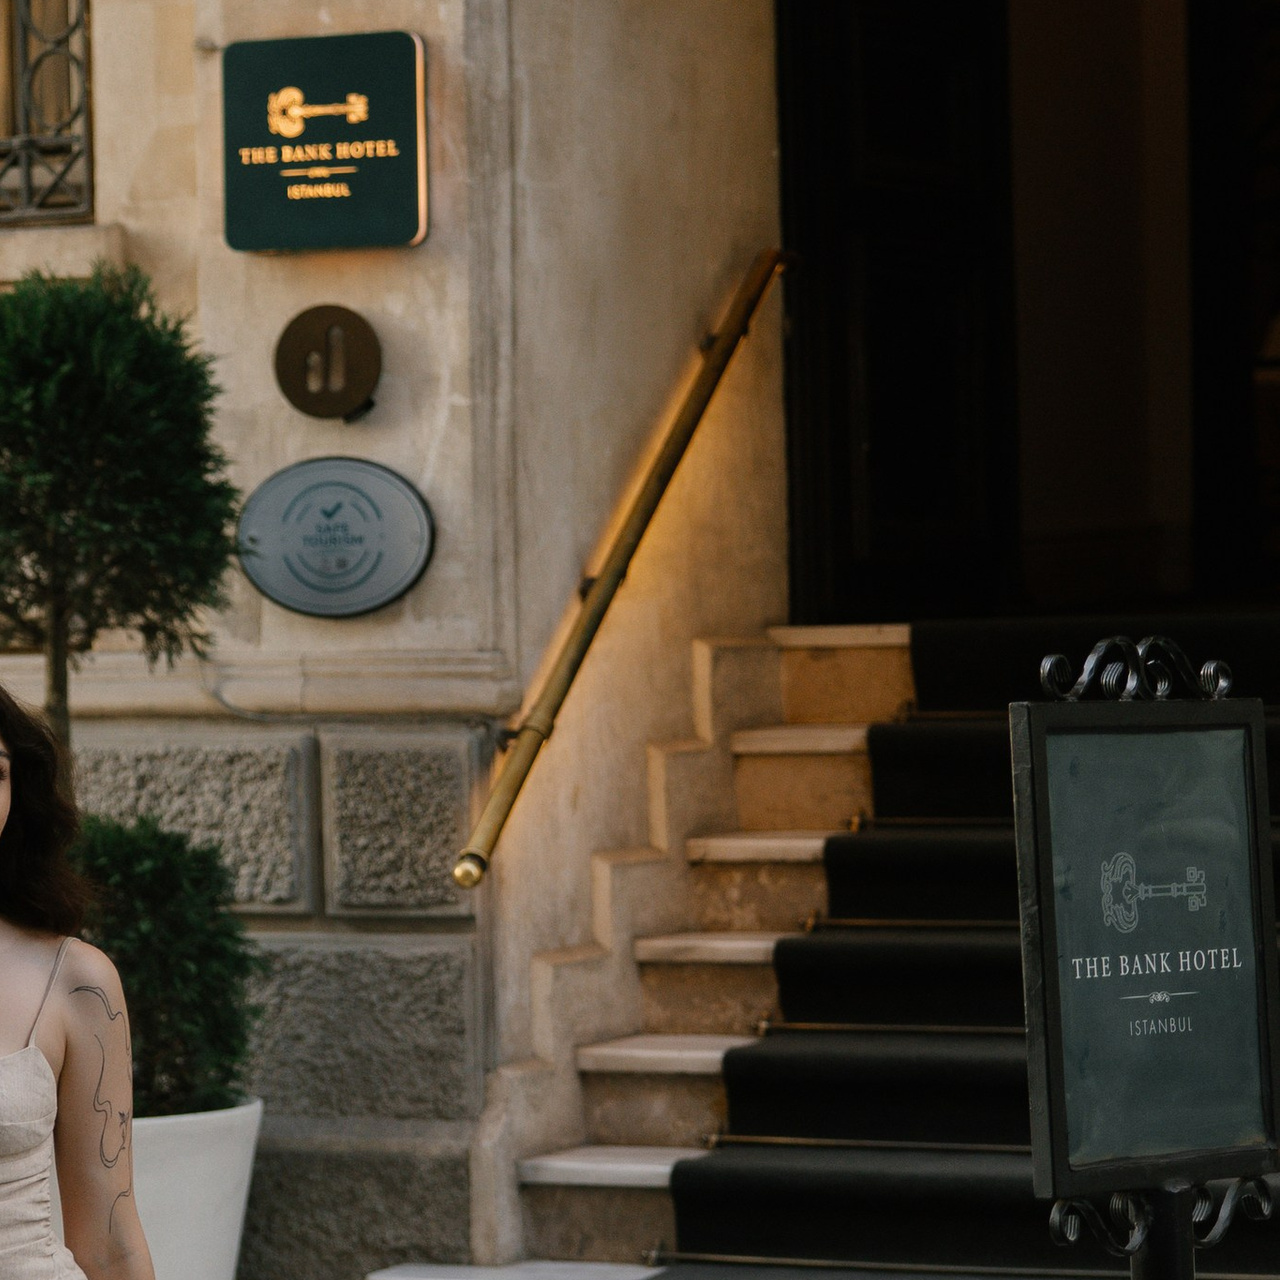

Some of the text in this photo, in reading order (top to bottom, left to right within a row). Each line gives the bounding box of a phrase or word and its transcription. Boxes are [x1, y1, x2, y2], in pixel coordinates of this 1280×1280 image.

[239, 140, 400, 165] THE BANK HOTEL
[287, 182, 352, 200] ISTANBUL
[1072, 947, 1243, 979] THE BANK HOTEL
[1129, 1016, 1193, 1036] ISTANBUL
